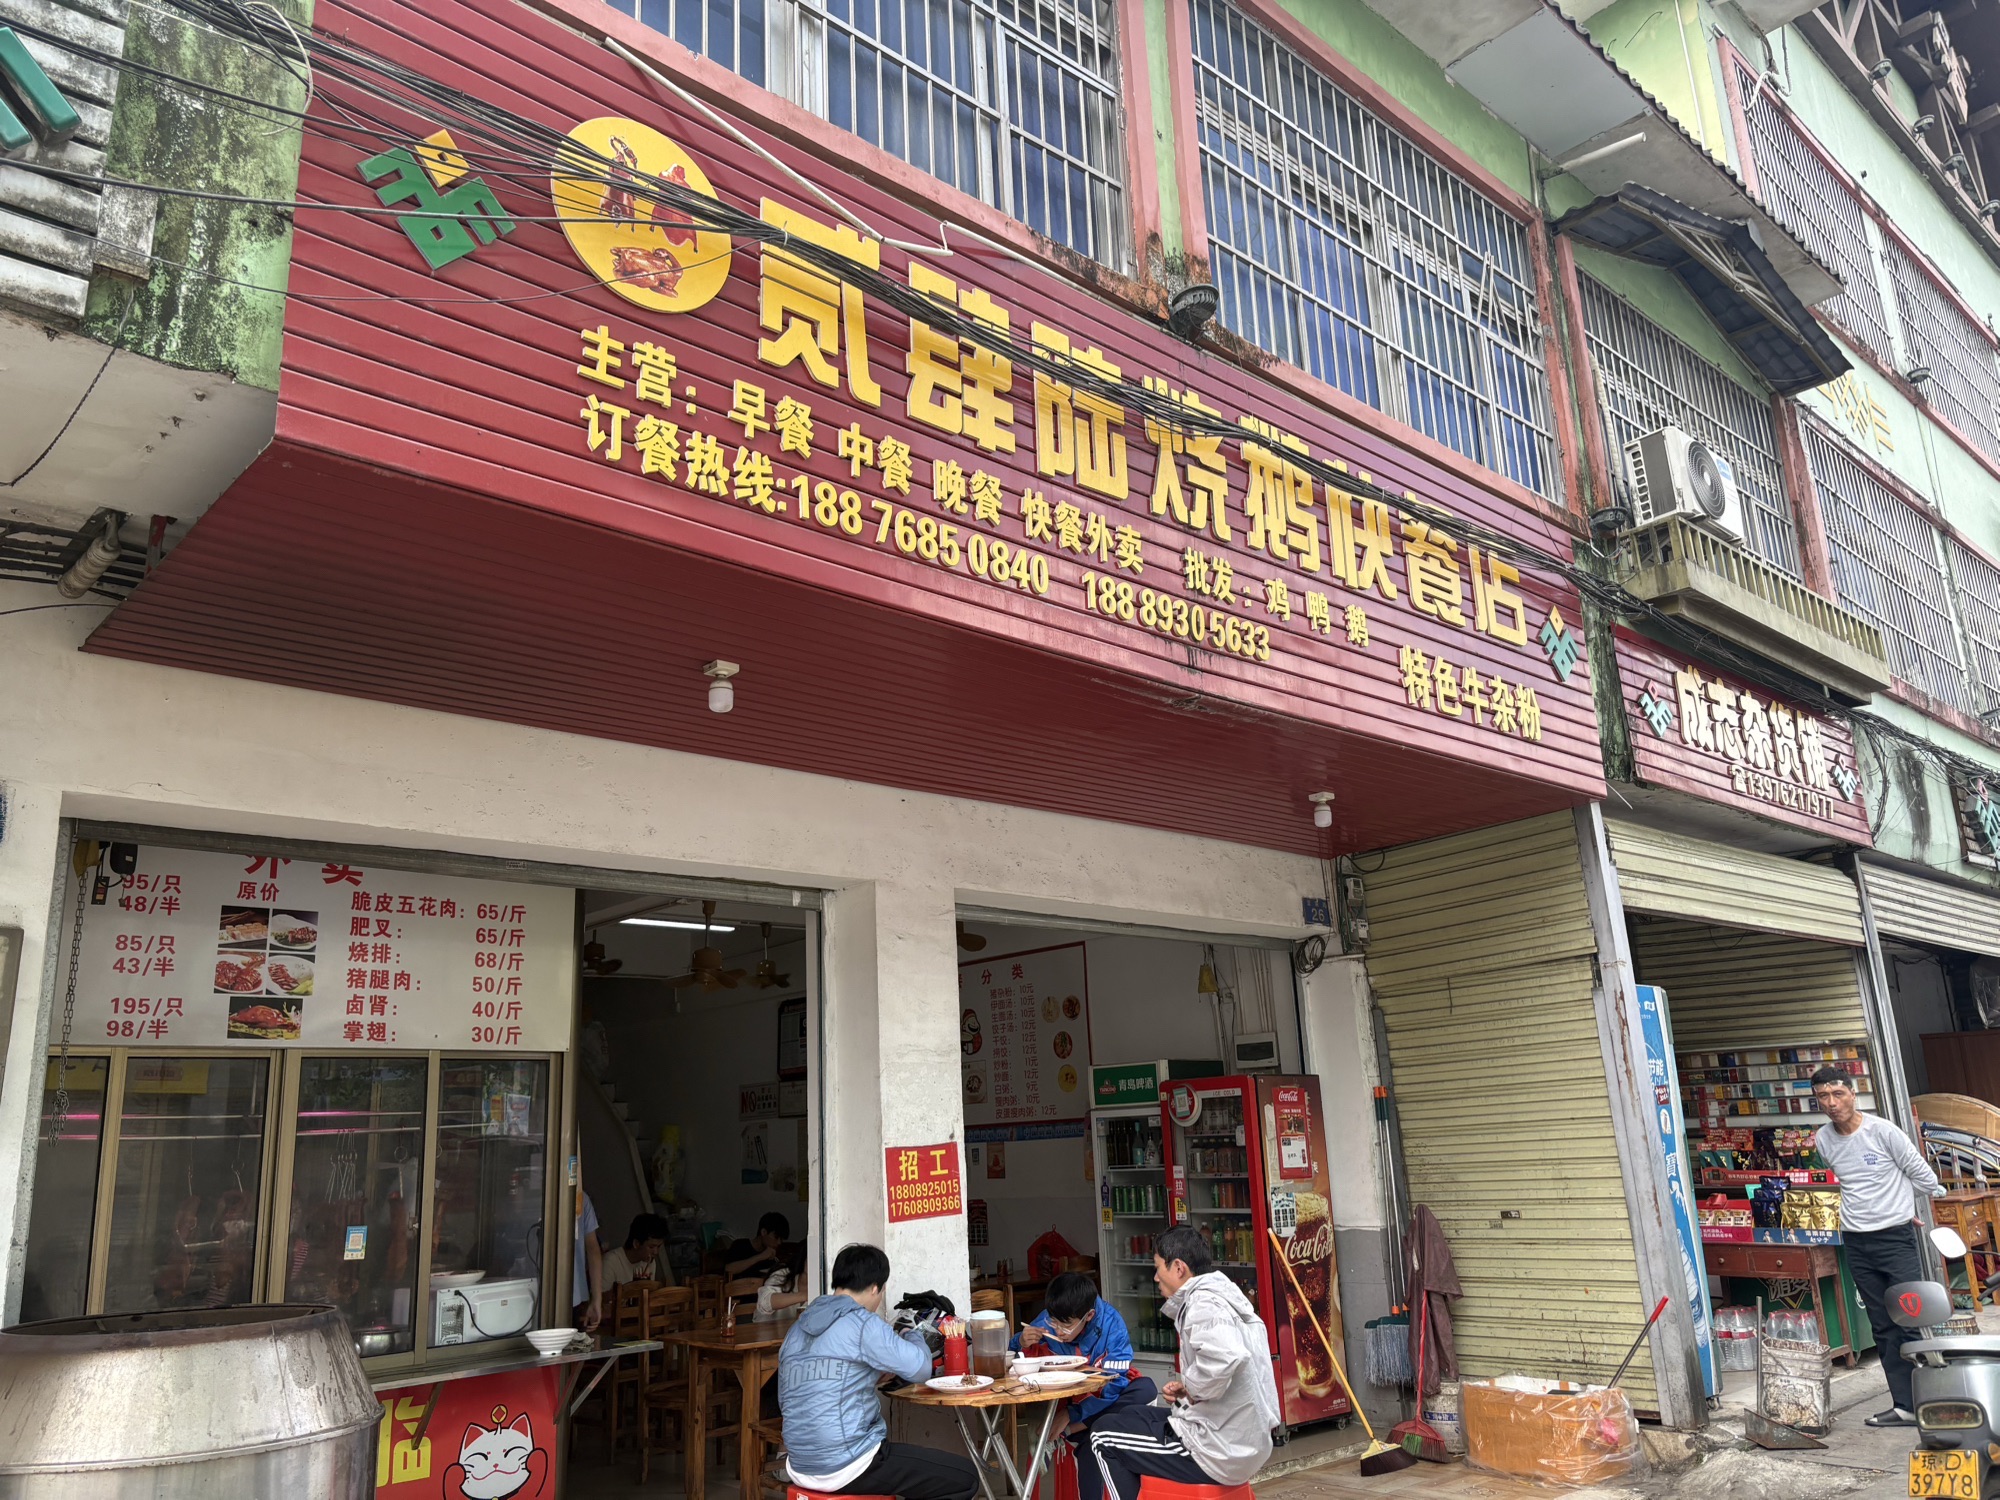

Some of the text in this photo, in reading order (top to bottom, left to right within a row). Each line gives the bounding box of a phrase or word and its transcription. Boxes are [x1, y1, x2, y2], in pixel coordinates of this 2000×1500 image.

[727, 378, 815, 460] 早餐
[838, 422, 913, 496] 中餐
[932, 457, 1003, 528] 晚餐
[1397, 643, 1542, 741] 特色牛杂粉
[235, 880, 281, 902] 原价
[476, 903, 527, 924] 65/斤
[1311, 907, 1325, 922] 26
[114, 933, 176, 955] 85/只
[475, 927, 526, 948] 65/斤
[112, 956, 175, 977] 43/半
[474, 951, 525, 972] 68/斤
[472, 976, 523, 996] 50/斤
[110, 997, 184, 1017] 195/只
[472, 1000, 523, 1021] 40/斤
[106, 1018, 170, 1040] 98/半
[471, 1025, 523, 1046] 30/斤
[1118, 1077, 1155, 1091] 青岛啤酒
[898, 1149, 949, 1181] 招工
[890, 1179, 959, 1200] 18808925015
[890, 1195, 960, 1217] 17608909366
[1911, 1473, 1974, 1497] 397Y8
